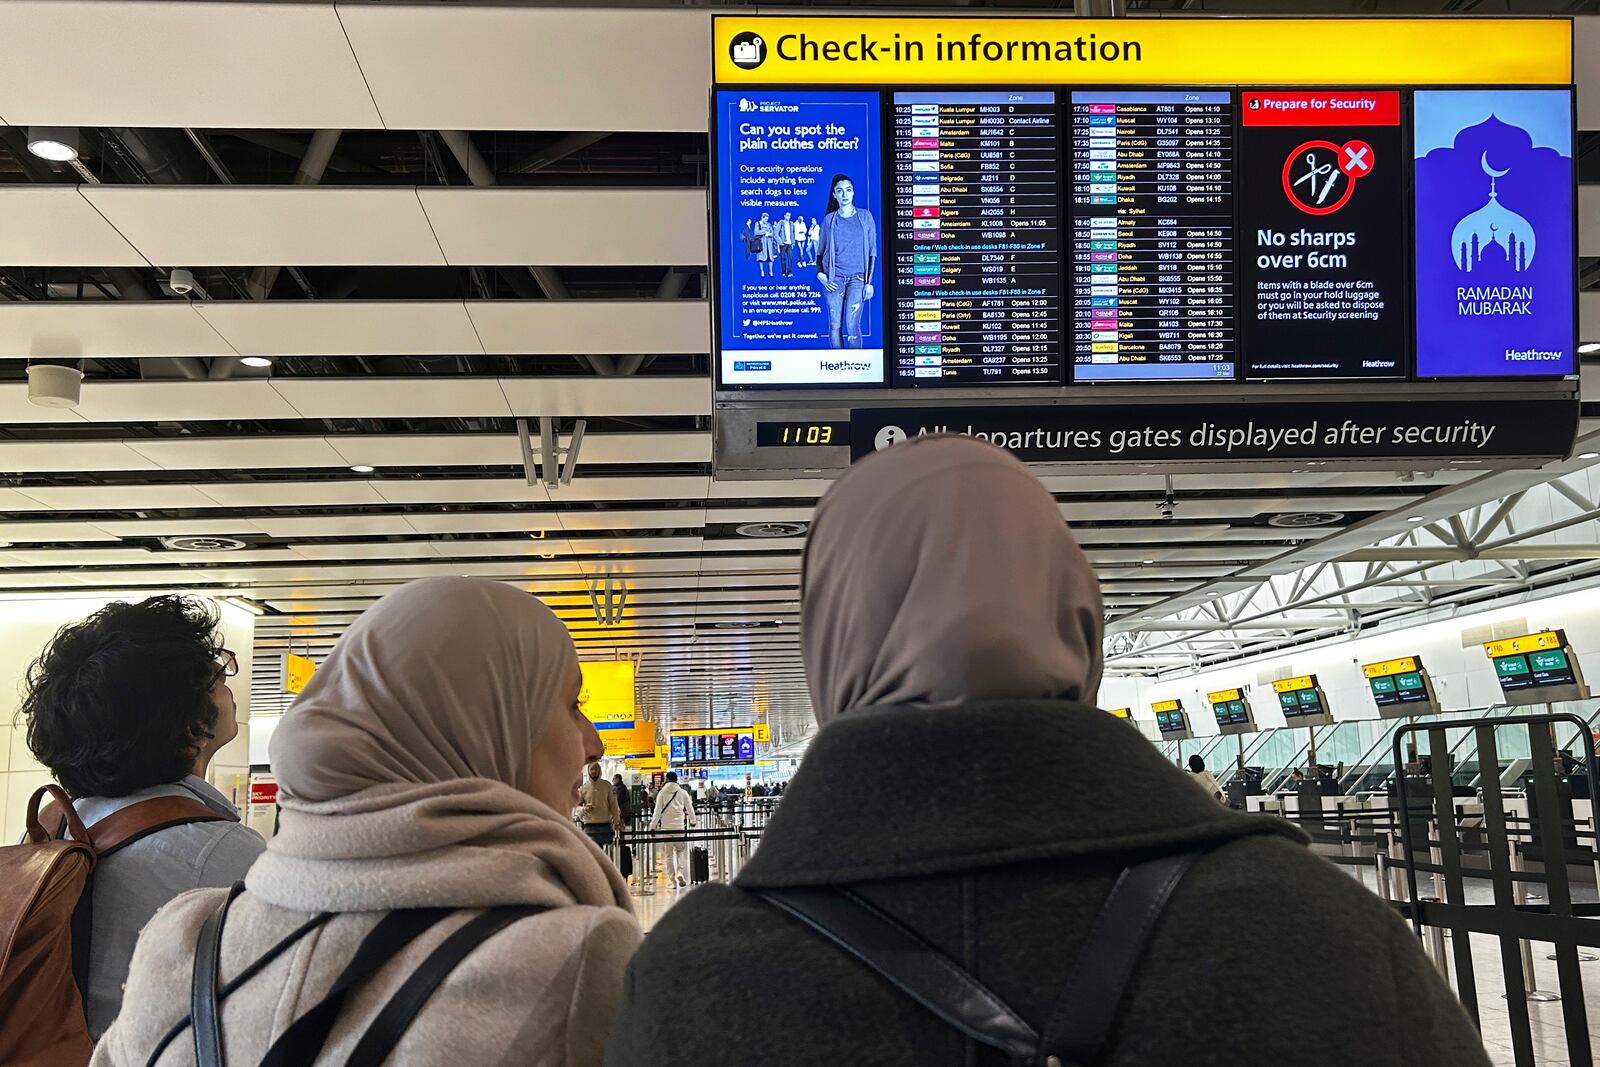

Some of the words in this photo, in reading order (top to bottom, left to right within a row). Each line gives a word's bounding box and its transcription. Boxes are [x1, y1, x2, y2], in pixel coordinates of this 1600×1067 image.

[776, 33, 924, 62] Check-in
[937, 33, 1142, 61] information
[1264, 99, 1307, 111] Prepare
[1310, 99, 1327, 108] for
[1330, 98, 1376, 110] Security
[740, 124, 764, 135] Can
[768, 126, 790, 137] you
[795, 125, 821, 137] spot
[826, 124, 845, 134] the
[740, 138, 767, 151] plain
[772, 138, 814, 149] clothes
[818, 137, 859, 150] officer?
[757, 165, 784, 174] security
[786, 165, 822, 174] operations
[768, 177, 796, 185] anything
[1258, 230, 1285, 246] No
[1290, 229, 1356, 249] sharps
[1257, 254, 1302, 268] over
[1308, 252, 1346, 268] 6cm
[1345, 291, 1379, 300] luggage
[1457, 287, 1532, 300] RAMADAN
[1269, 303, 1284, 311] you
[1353, 301, 1384, 310] dispose
[1459, 302, 1531, 315] MUBARAK
[1303, 311, 1336, 320] Security
[1338, 311, 1378, 320] screening
[1506, 349, 1562, 360] Heathrow
[820, 361, 871, 370] Heathrow
[1109, 422, 1181, 452] gates
[1189, 421, 1316, 452] displayed
[1324, 420, 1386, 444] after
[1392, 420, 1495, 448] security
[758, 729, 764, 739] E
